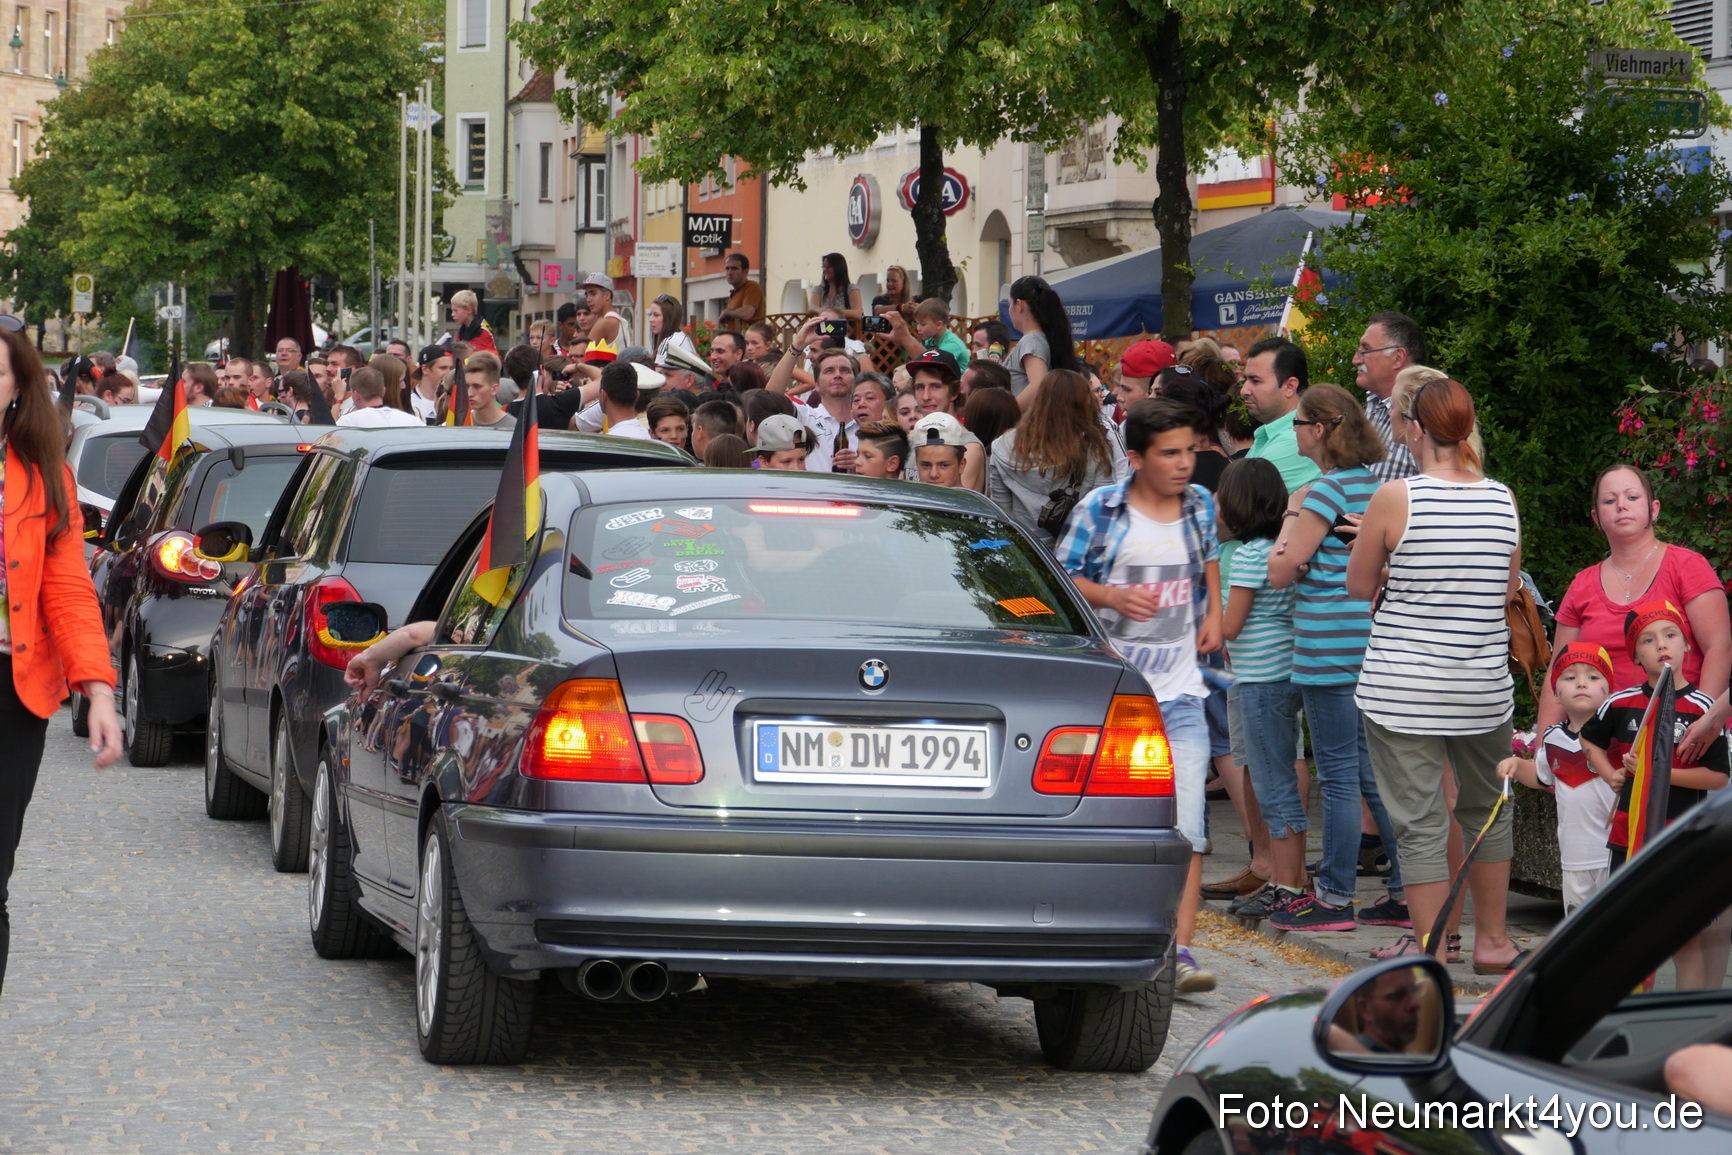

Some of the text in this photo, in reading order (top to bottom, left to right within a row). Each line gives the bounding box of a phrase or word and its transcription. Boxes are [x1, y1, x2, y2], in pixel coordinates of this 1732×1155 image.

[1606, 53, 1686, 75] Viehmarkt
[688, 217, 730, 231] MATT
[692, 233, 722, 245] optik
[165, 308, 180, 317] WC
[189, 587, 217, 596] TOYOTA
[613, 590, 676, 606] YOLO
[1555, 651, 1610, 676] DEUTSCHLAND
[764, 753, 773, 764] D
[782, 732, 981, 771] NM DW 1994
